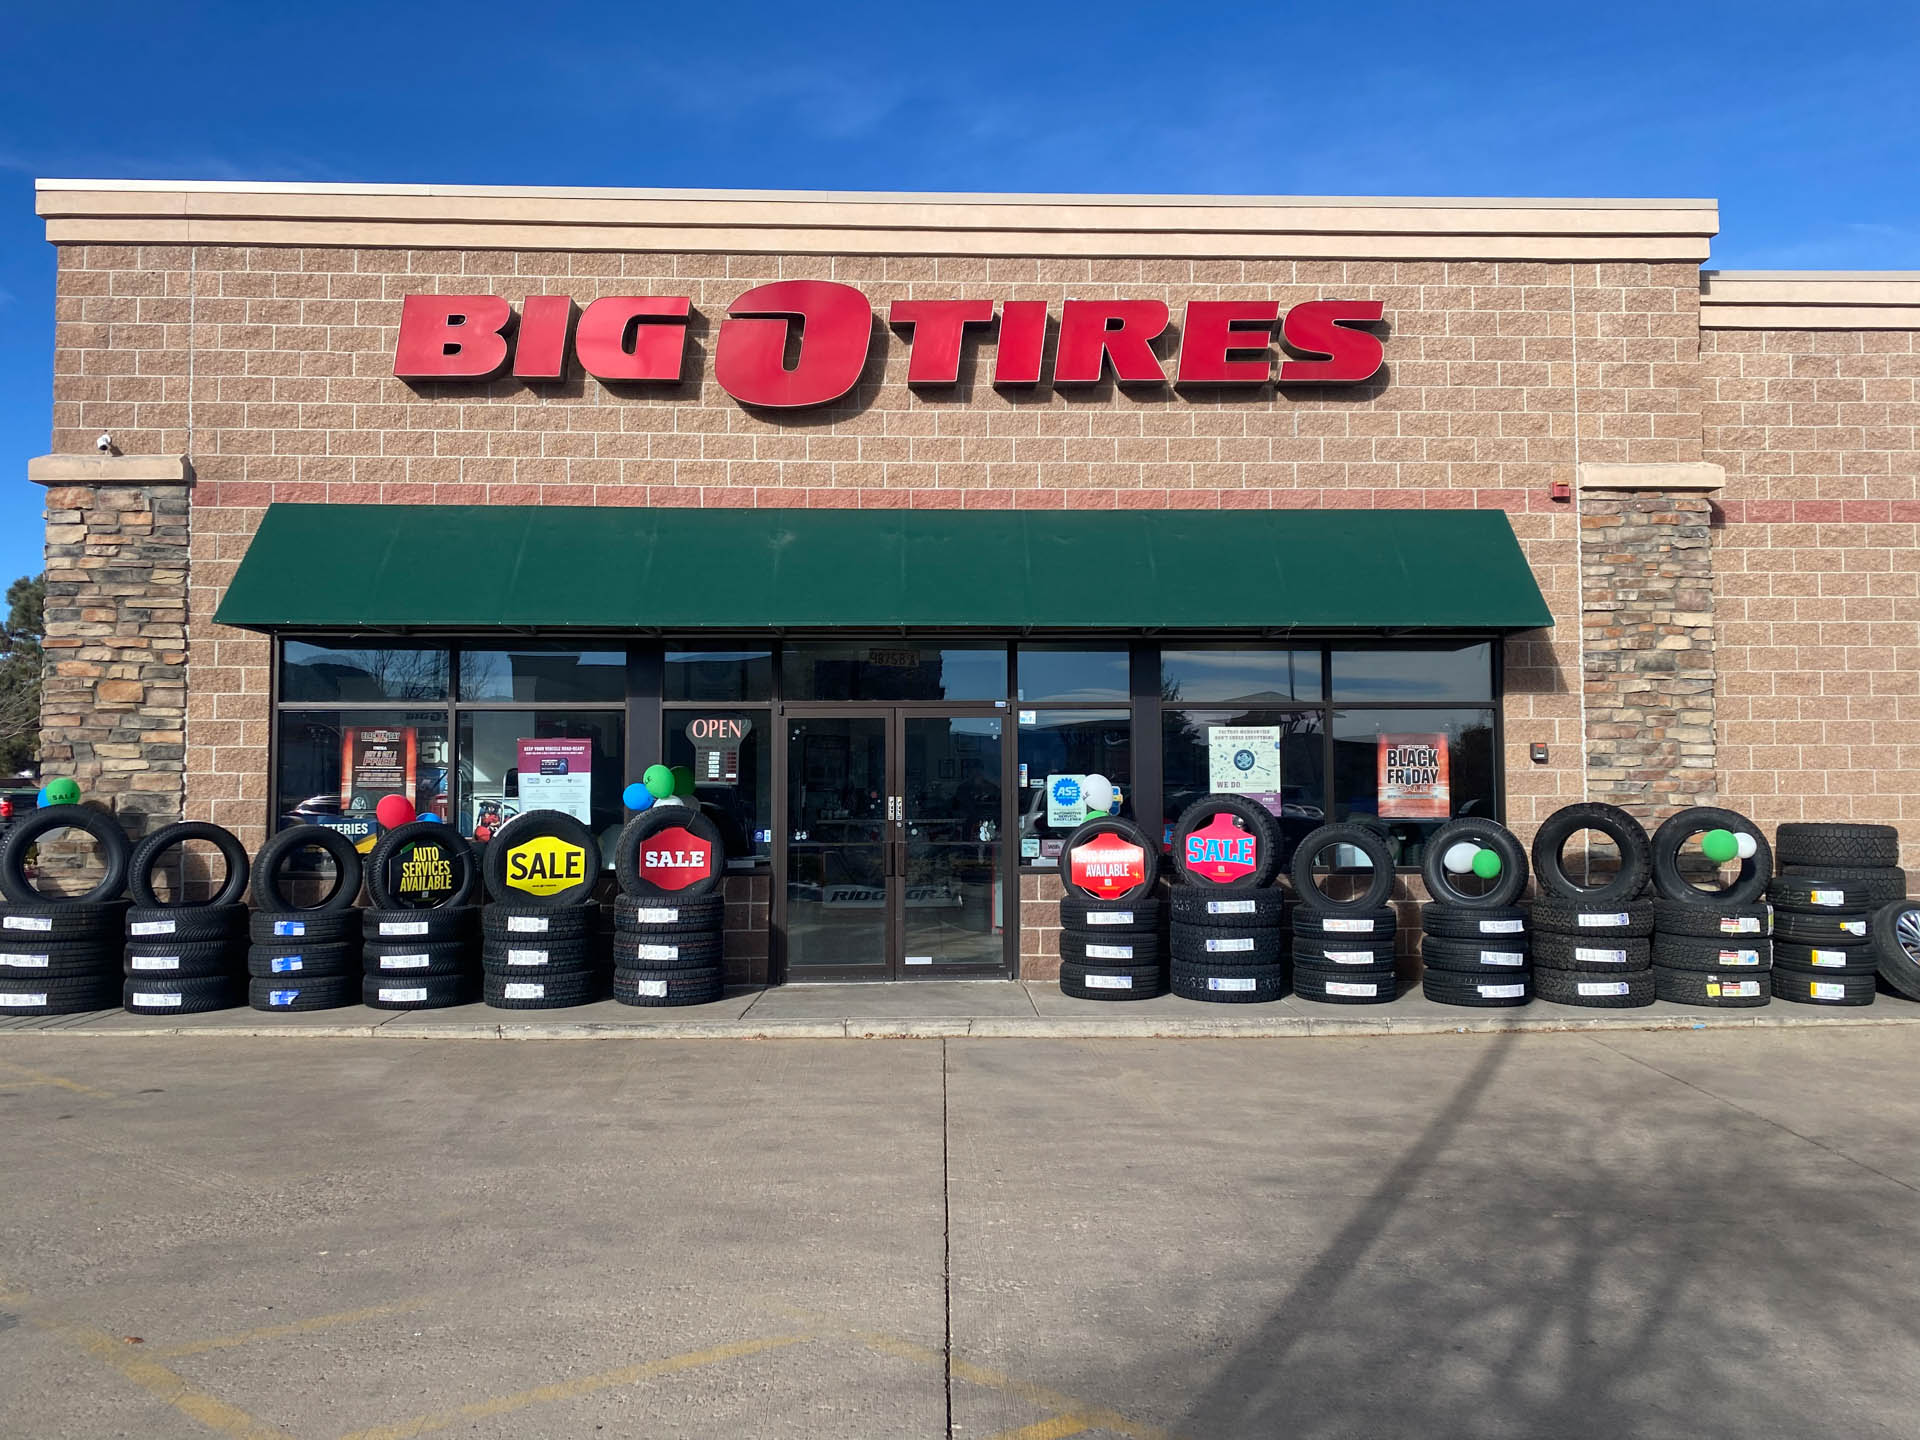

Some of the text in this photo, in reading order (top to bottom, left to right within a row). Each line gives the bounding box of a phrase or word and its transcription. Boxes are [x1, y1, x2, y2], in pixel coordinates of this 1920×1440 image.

[393, 279, 1385, 408] BIG O TIRES
[692, 718, 742, 739] OPEN
[1386, 748, 1440, 767] BLACK
[1386, 767, 1440, 786] FRIDAY
[52, 792, 76, 801] SALE
[1056, 786, 1079, 796] ASE
[319, 823, 368, 835] TERIES
[413, 846, 440, 862] AUTO
[645, 850, 705, 868] SALE
[1188, 836, 1255, 866] SALE
[402, 860, 450, 877] SERVICES
[510, 851, 582, 880] SALE
[1086, 863, 1130, 877] AVAILABLE
[399, 874, 453, 892] AVAILABLE
[831, 889, 886, 902] RIDG
